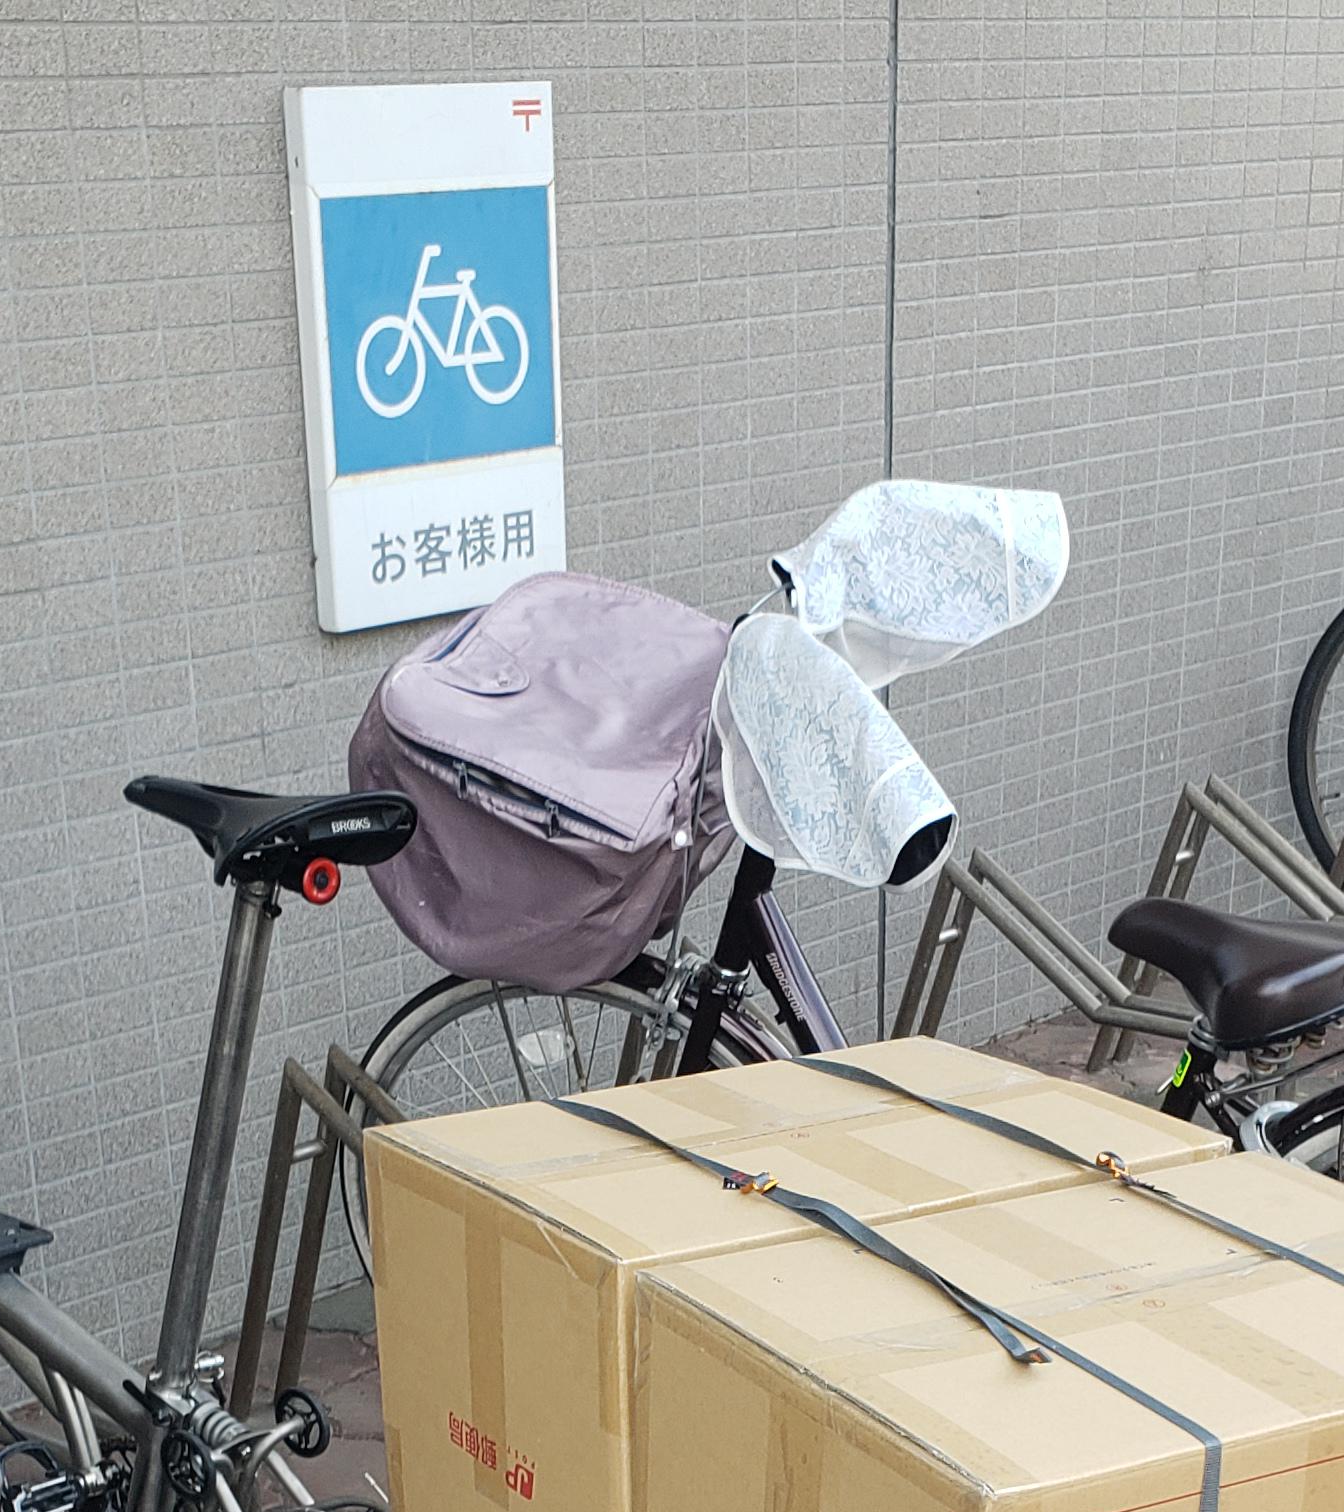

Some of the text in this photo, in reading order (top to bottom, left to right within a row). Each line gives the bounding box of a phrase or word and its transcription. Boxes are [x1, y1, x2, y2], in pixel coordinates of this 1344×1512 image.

[370, 509, 536, 585] お客様用
[448, 1411, 497, 1471] 郵便局
